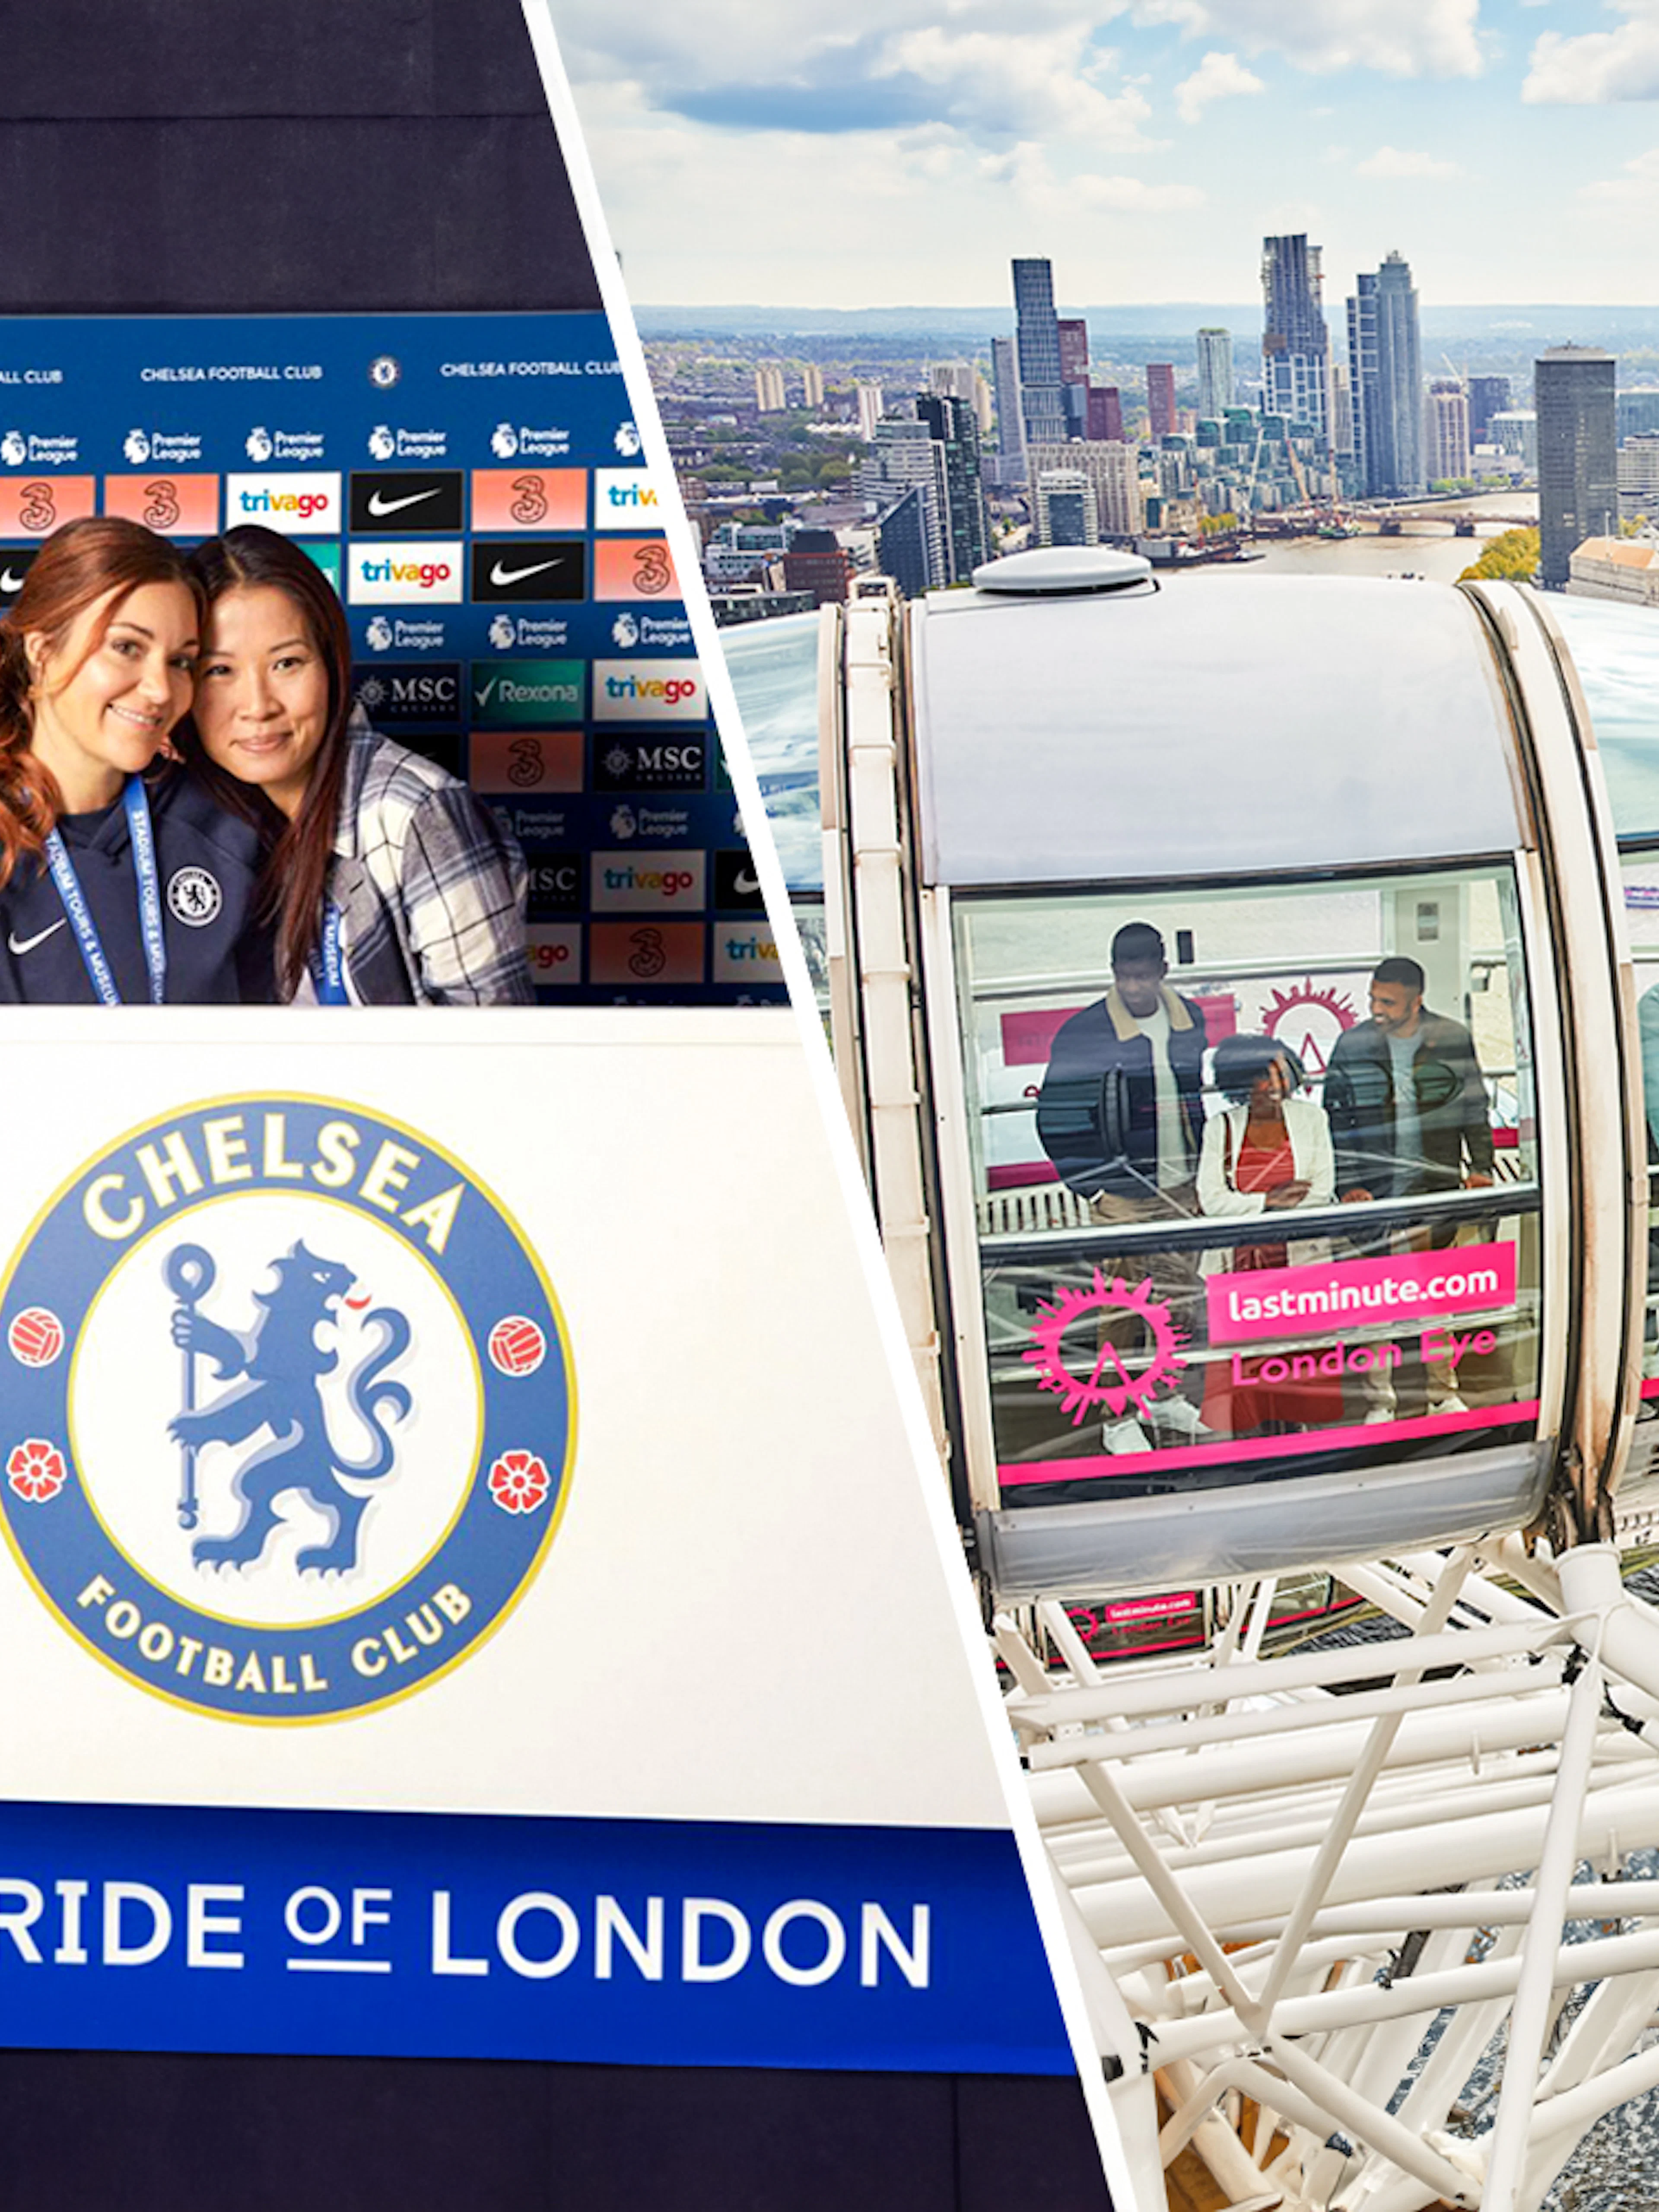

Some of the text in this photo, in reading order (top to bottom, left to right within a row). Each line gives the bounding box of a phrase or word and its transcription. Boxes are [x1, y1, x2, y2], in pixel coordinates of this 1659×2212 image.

[23, 369, 63, 384] CLUB
[140, 365, 324, 382] CHELSEA FOOTBALL CLUB
[440, 362, 505, 377] CHELSEA
[509, 361, 582, 376] FOOTBALL
[28, 434, 79, 449] Premier
[152, 432, 202, 447] Premier
[274, 431, 324, 445] Premier
[397, 429, 447, 443] Premier
[520, 427, 570, 442] Premier
[28, 448, 78, 465] League
[152, 446, 202, 464] League
[274, 445, 324, 461] League
[397, 442, 447, 459] League
[520, 441, 570, 457] League
[240, 489, 329, 518] trivago
[360, 559, 451, 588] trivago
[395, 620, 445, 634] Premier
[518, 618, 567, 632] Premier
[641, 616, 689, 630] Premier
[395, 633, 445, 651] League
[518, 632, 567, 648] League
[641, 631, 690, 647] League
[390, 676, 456, 702] MSC
[499, 680, 578, 703] Rexona
[606, 674, 696, 706] trivago
[636, 746, 702, 772] MSC
[515, 809, 565, 823] Premier
[638, 807, 690, 823] Premier
[515, 823, 565, 839] League
[638, 822, 689, 839] League
[604, 868, 692, 896] trivago
[82, 1113, 466, 1255] CHELSEA
[1229, 1268, 1498, 1322] lastminute.com
[1232, 1327, 1497, 1386] London Eye
[76, 1574, 473, 1694] FOOTBALL CLUB
[0, 1878, 931, 1988] RIDE OF LONDON
